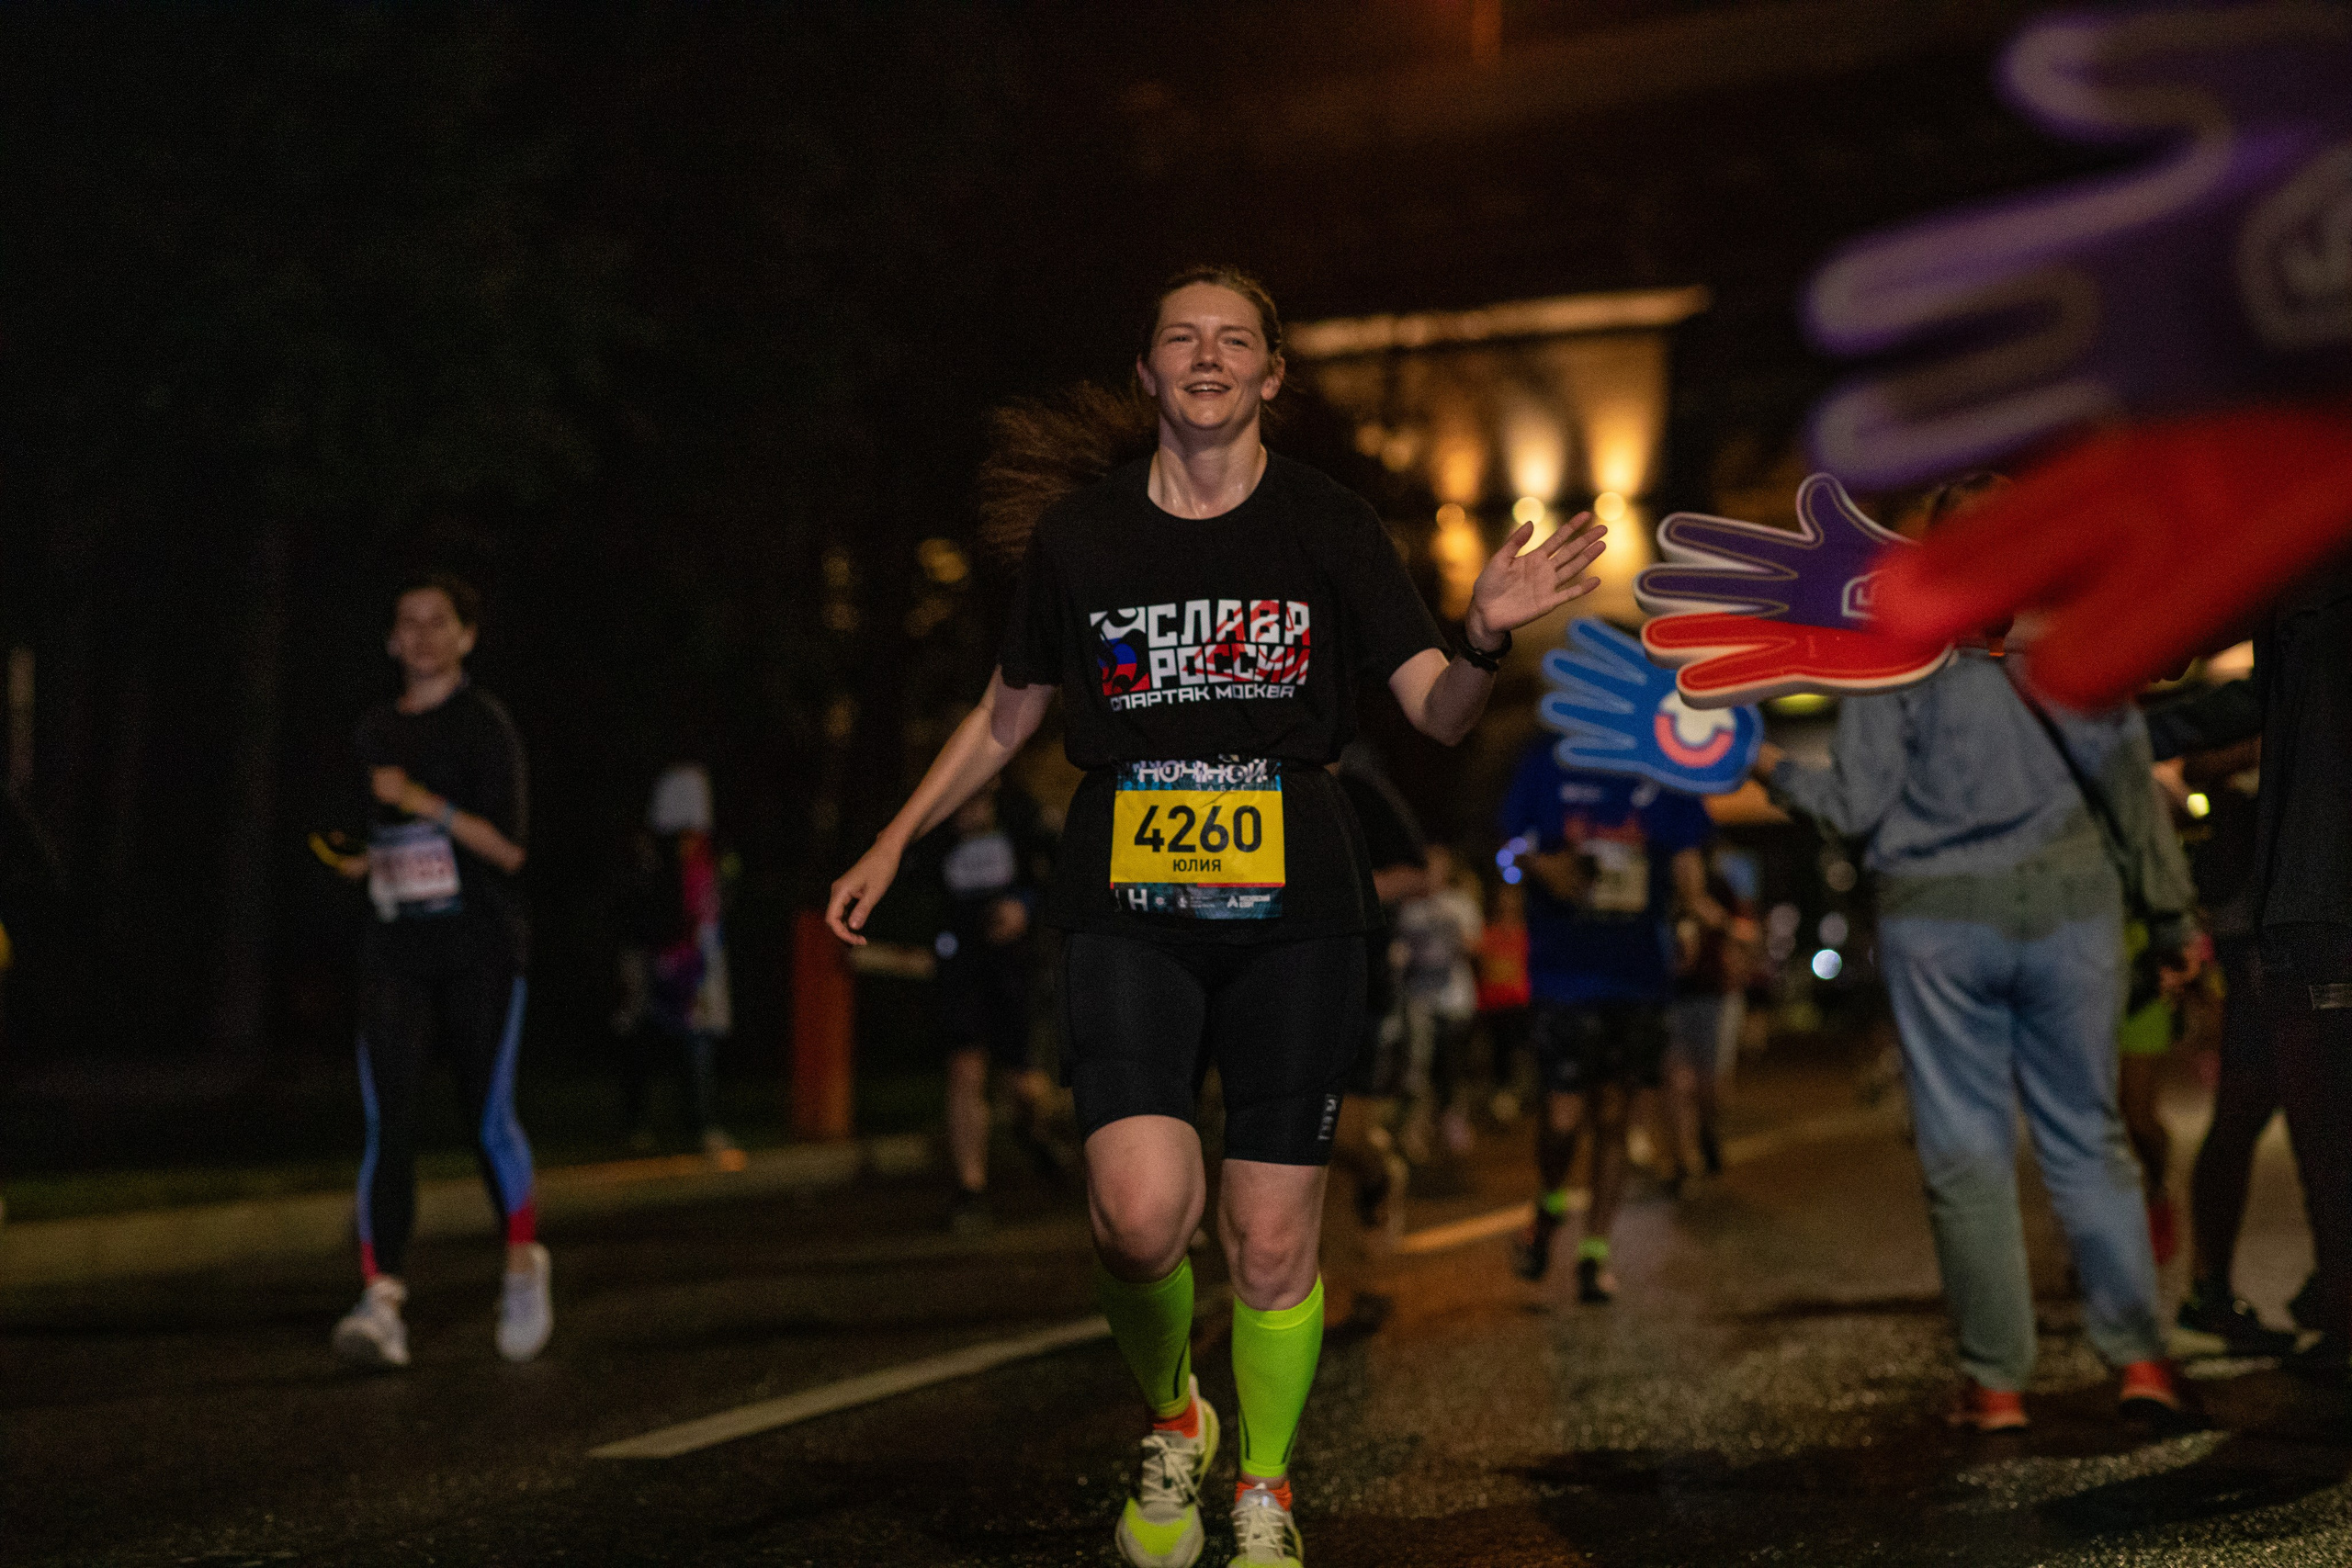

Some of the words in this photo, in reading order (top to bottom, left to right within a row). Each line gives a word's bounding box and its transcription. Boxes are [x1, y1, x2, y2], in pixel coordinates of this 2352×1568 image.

[1148, 599, 1311, 648] СЛАВА
[1148, 643, 1311, 689] РОССИИ
[1110, 686, 1211, 712] СПАРТАК
[1215, 683, 1295, 700] МОСКВА
[1134, 805, 1262, 853] 4260
[1172, 859, 1222, 873] ЮЛИЯ
